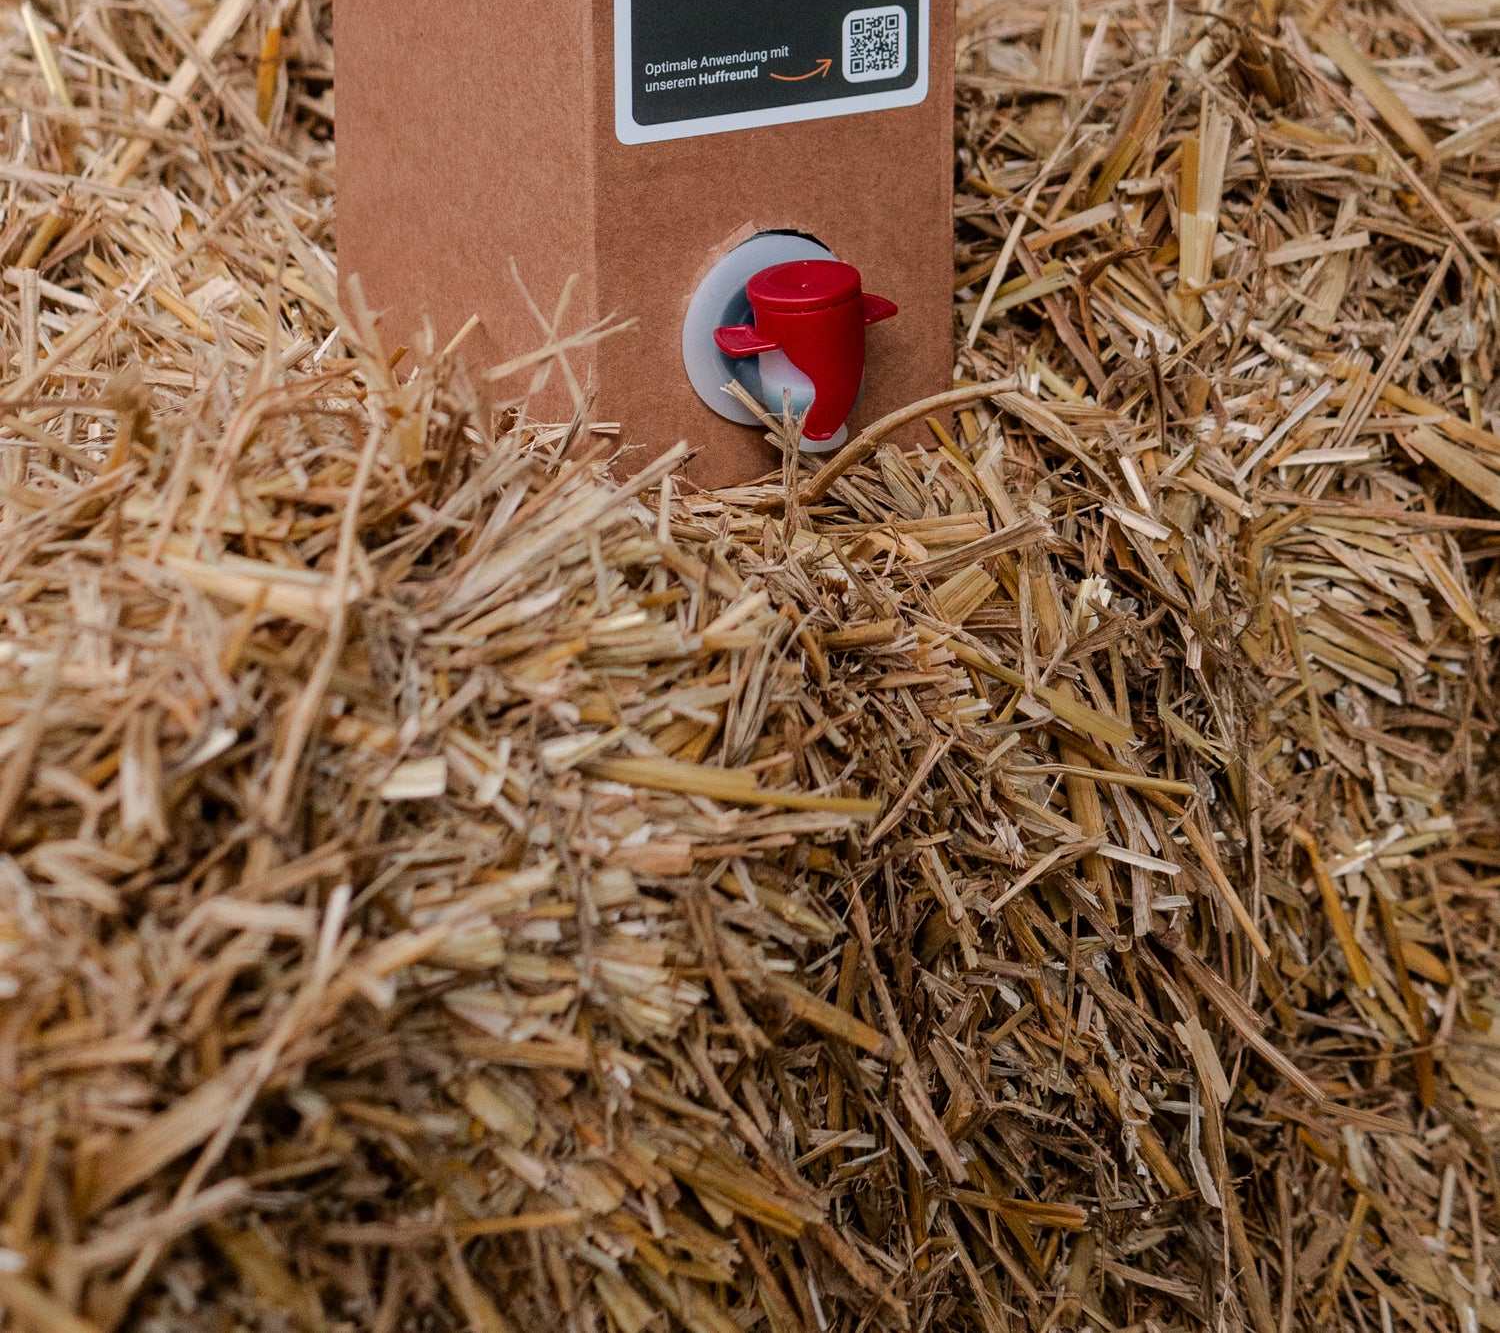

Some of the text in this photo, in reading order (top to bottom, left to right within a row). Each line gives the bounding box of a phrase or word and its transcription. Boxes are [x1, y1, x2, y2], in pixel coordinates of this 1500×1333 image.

[645, 45, 790, 77] Optimale Anwendung mit
[645, 66, 759, 93] unserem Huffreund
